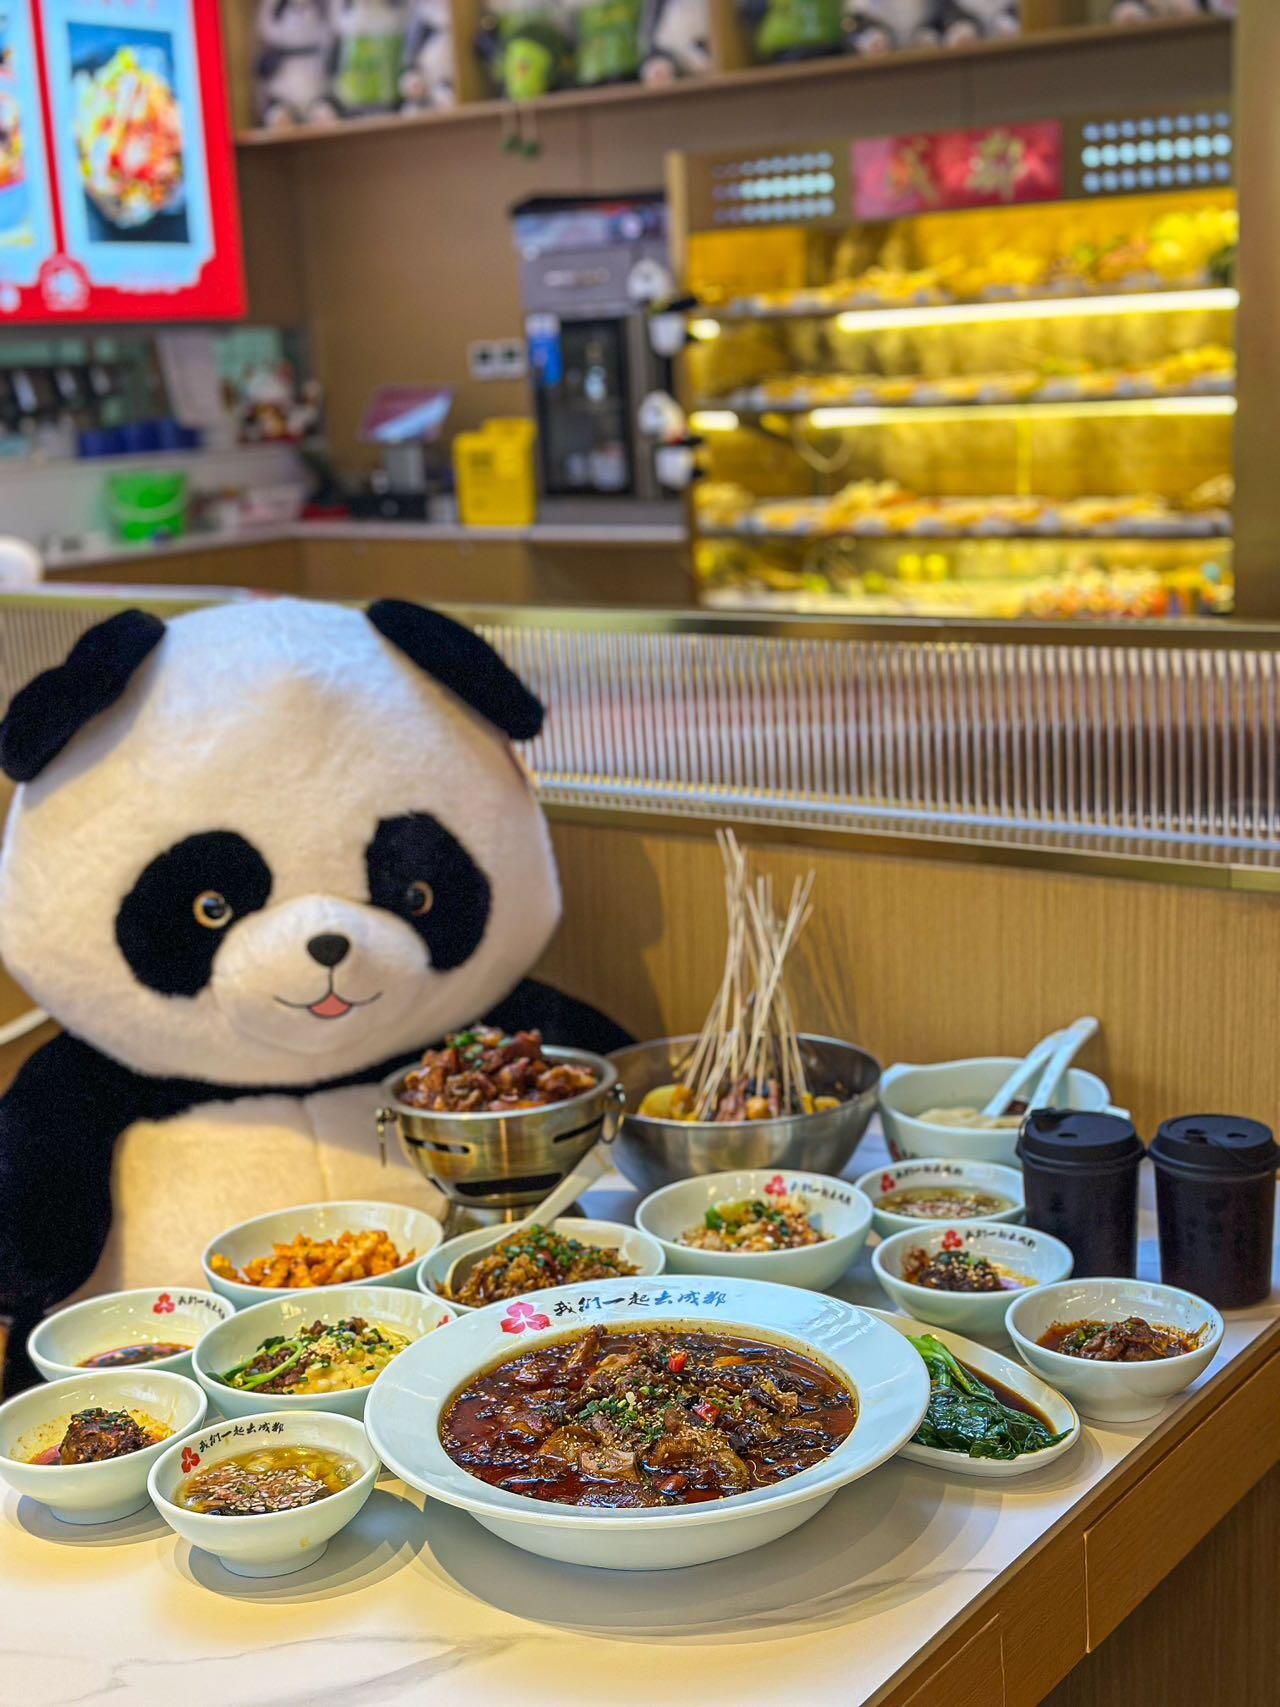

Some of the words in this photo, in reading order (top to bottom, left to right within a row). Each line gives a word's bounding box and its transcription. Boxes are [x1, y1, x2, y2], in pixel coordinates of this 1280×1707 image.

[553, 1290, 727, 1317] 我们一起去成都
[199, 1422, 285, 1453] 我们一起去成都
